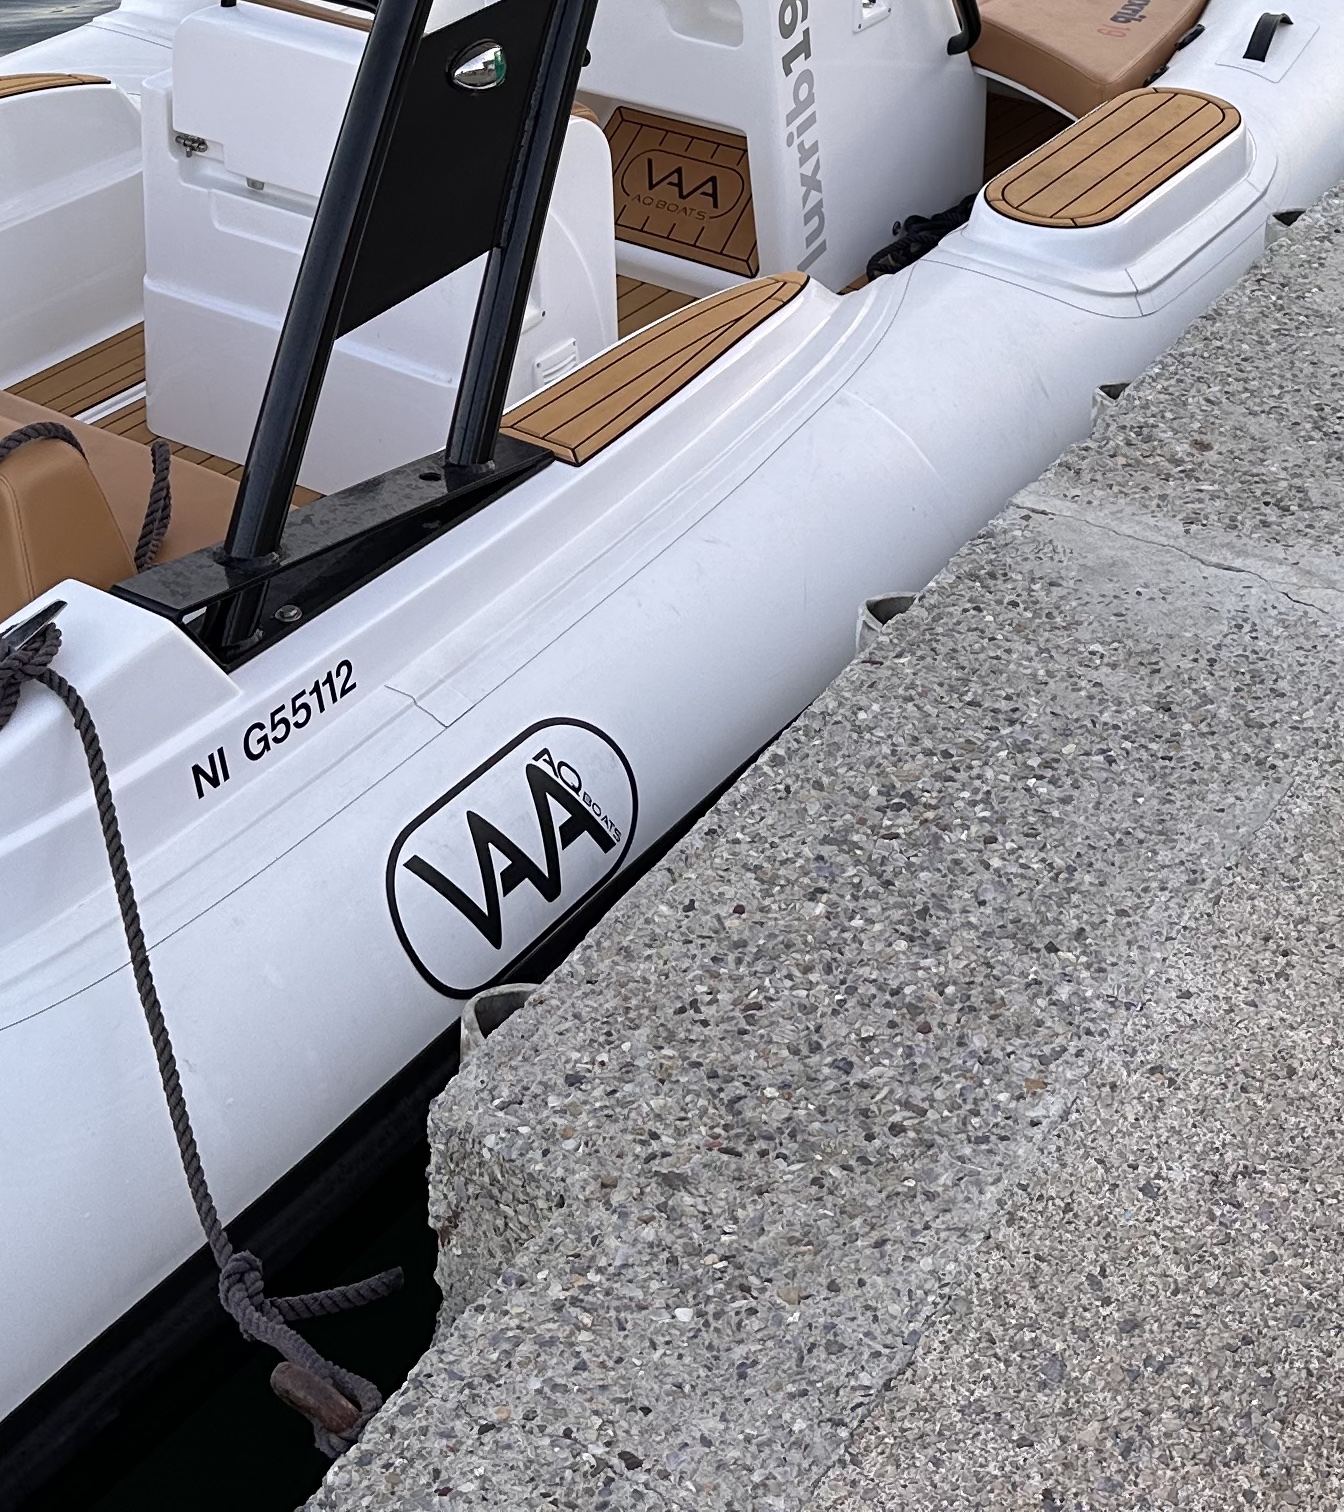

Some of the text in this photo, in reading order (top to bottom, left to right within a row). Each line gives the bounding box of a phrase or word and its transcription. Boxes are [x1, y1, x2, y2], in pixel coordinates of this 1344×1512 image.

[647, 157, 719, 209] VAA
[191, 659, 357, 799] NI G55112
[532, 748, 582, 798] AQ
[582, 791, 622, 843] BOATS
[403, 764, 617, 950] VAA
